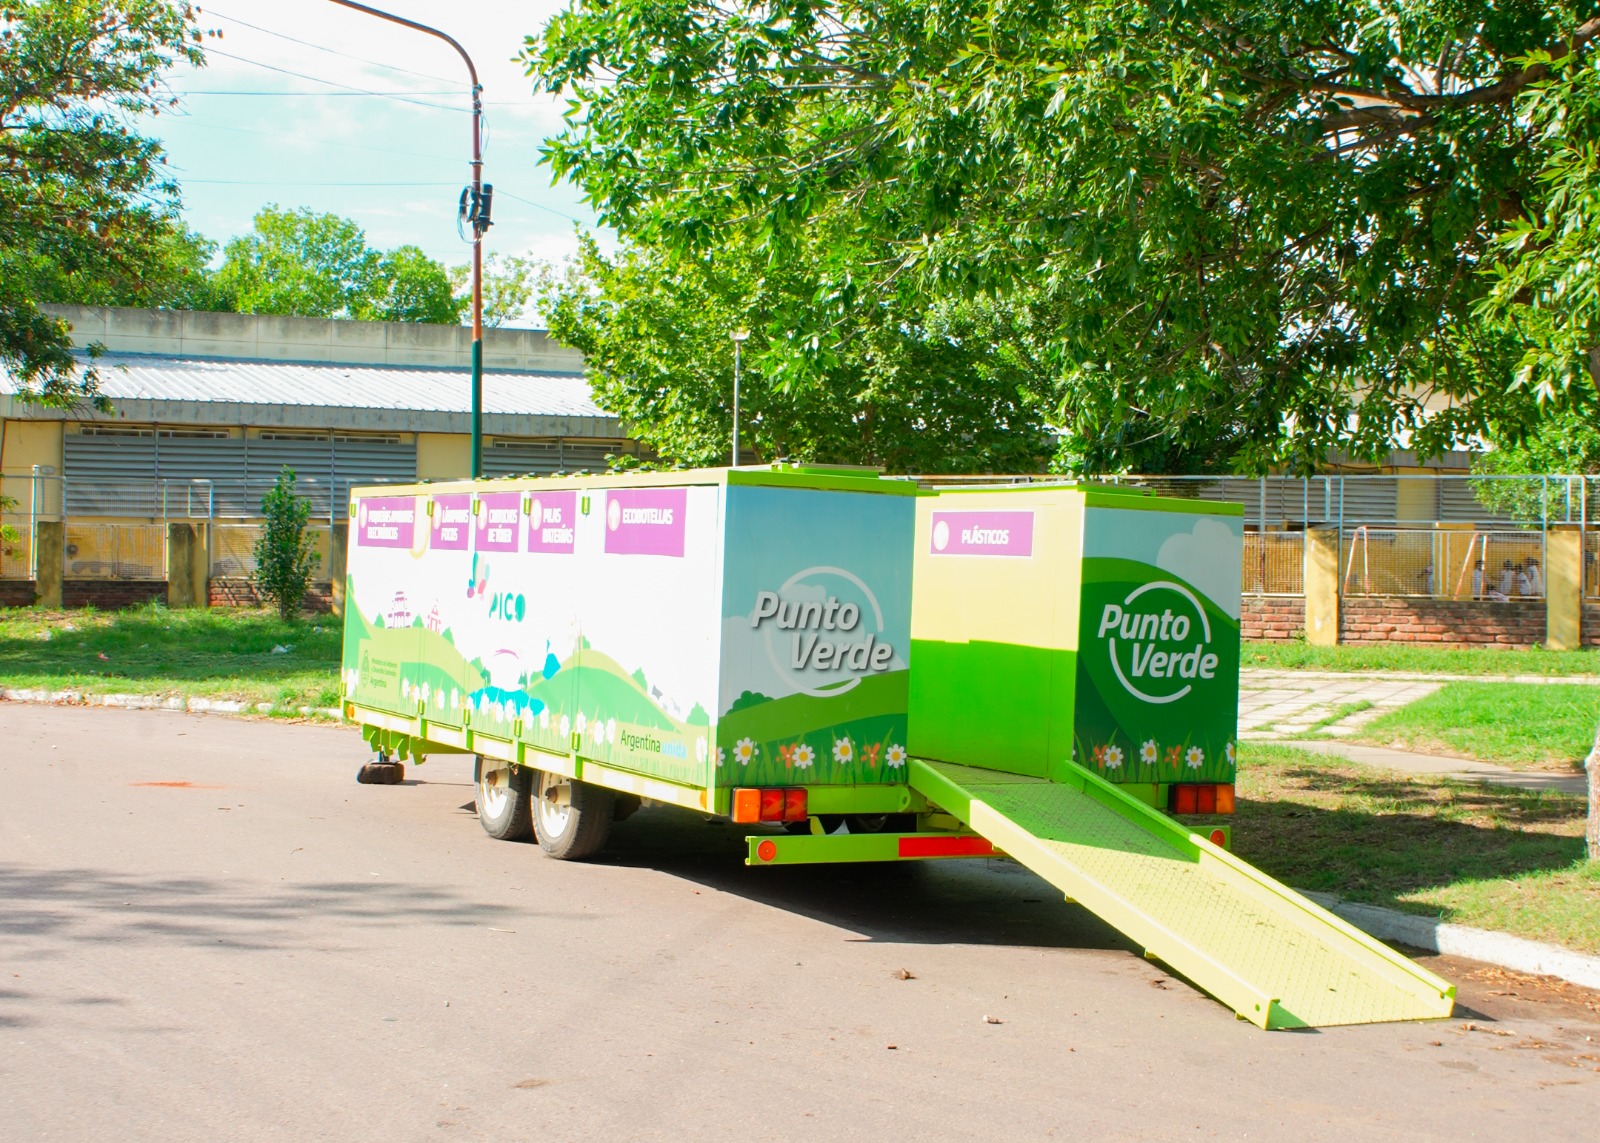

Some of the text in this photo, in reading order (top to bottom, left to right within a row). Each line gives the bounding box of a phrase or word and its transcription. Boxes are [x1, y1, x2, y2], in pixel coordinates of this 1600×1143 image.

[543, 508, 561, 523] PILAS
[622, 508, 673, 524] ECOBOTELLAS
[961, 524, 1009, 545] PLÁSTICOS
[488, 592, 526, 622] PICO
[751, 591, 859, 631] Punto
[1097, 603, 1191, 641] Punto
[791, 633, 893, 671] Verde
[1131, 641, 1219, 680] Verde
[620, 730, 687, 760] Argentina unida
